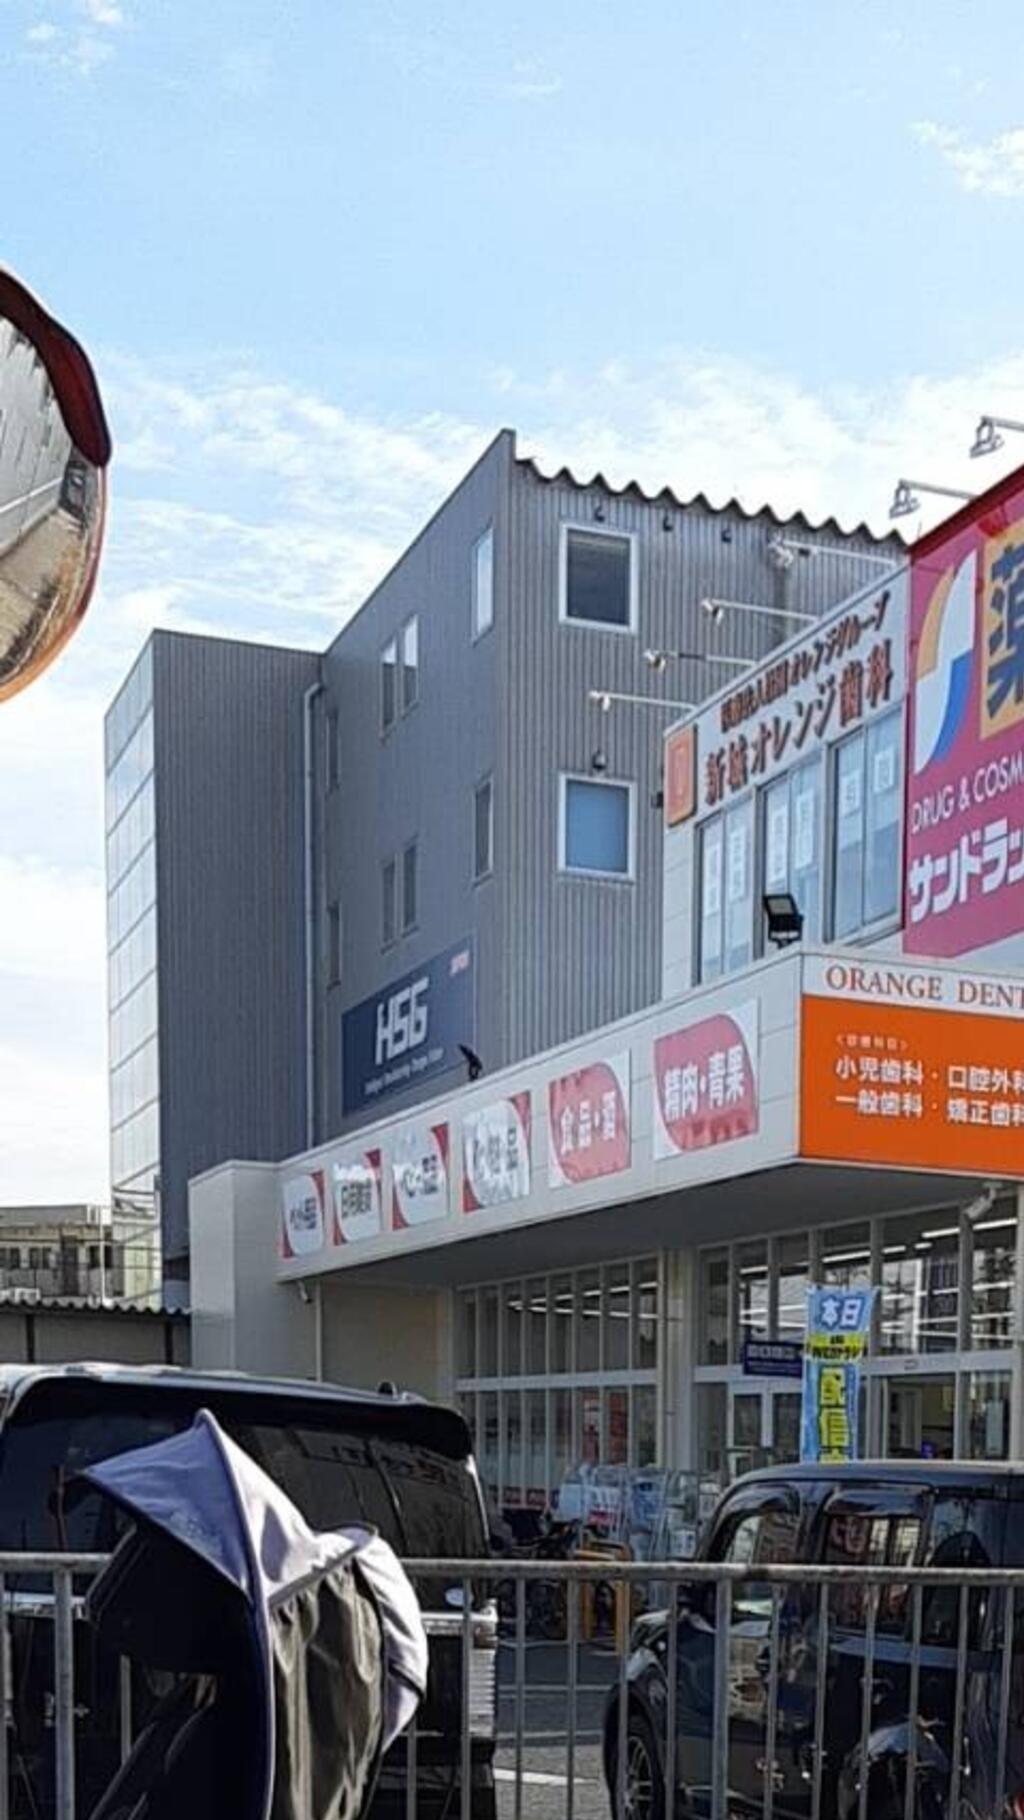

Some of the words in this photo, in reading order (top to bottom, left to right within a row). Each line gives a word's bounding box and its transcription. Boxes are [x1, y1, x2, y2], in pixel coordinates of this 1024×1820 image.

[911, 788, 957, 835] DRUG
[958, 783, 972, 812] &
[825, 963, 943, 1001] ORANGE
[820, 1296, 863, 1327] 本日
